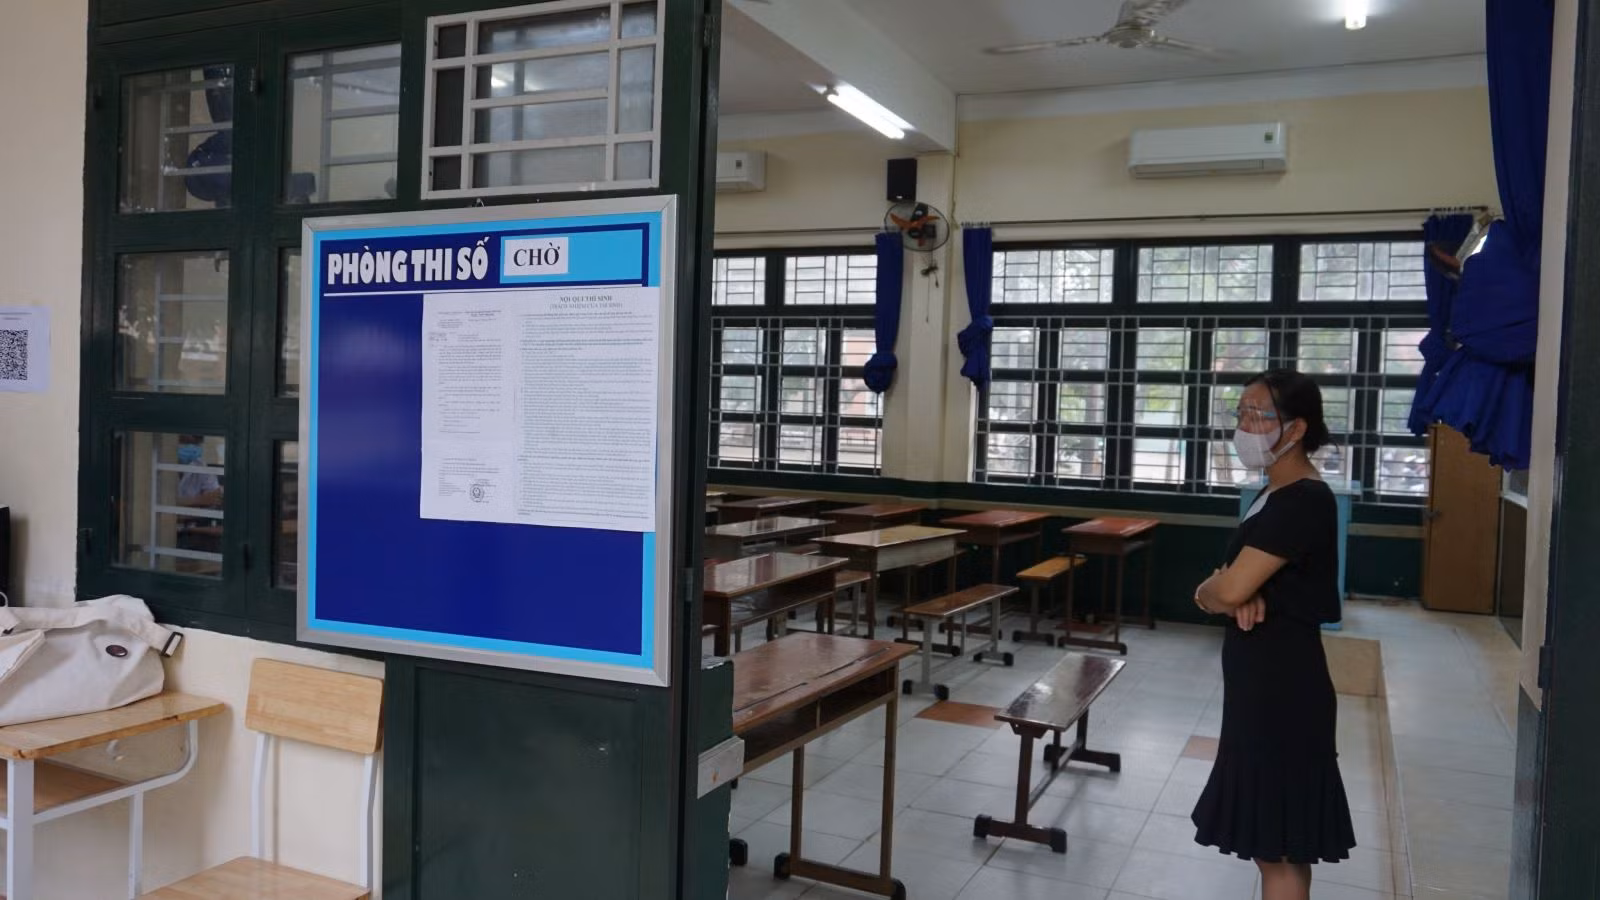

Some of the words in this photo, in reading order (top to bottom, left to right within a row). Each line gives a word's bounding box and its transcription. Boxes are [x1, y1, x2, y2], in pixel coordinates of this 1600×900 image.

[328, 245, 408, 285] PHÒNG
[411, 248, 452, 282] THI
[456, 236, 489, 280] SỐ
[513, 242, 560, 267] CHỜ
